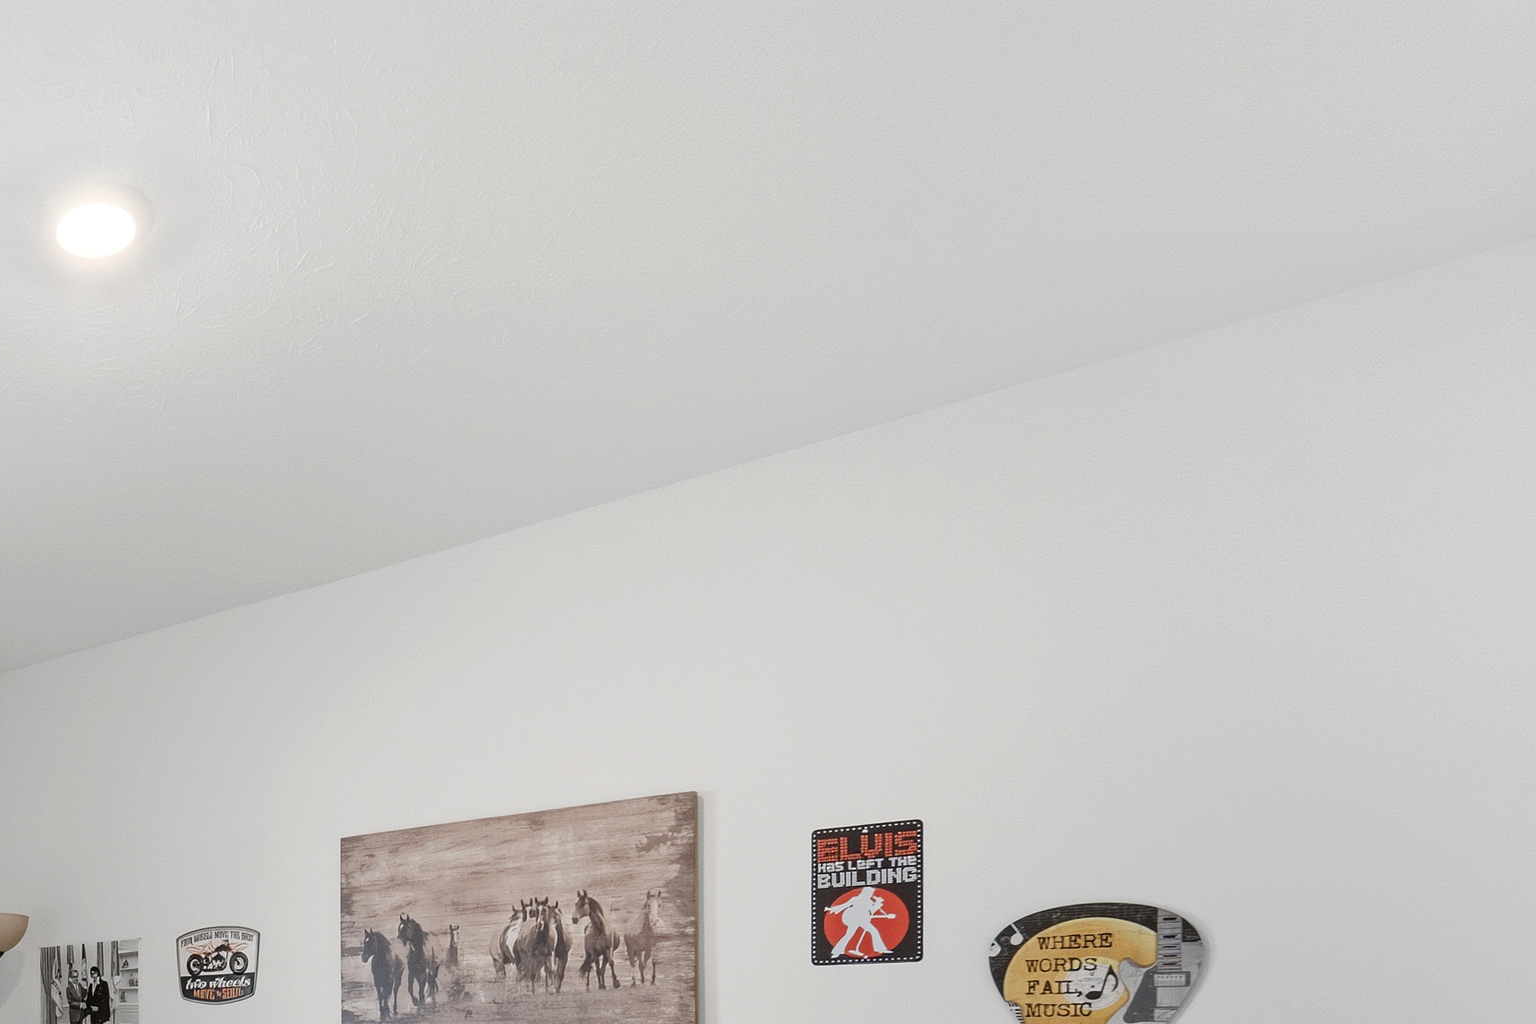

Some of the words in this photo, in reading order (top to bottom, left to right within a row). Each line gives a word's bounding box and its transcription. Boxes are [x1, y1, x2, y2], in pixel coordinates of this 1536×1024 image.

[817, 830, 917, 863] ELVIS
[818, 867, 917, 889] BUILDING
[1037, 933, 1113, 950] WHERE
[1025, 957, 1097, 972] WORDS
[1026, 980, 1082, 997] FAIL,
[1025, 1002, 1092, 1017] MUSIC
